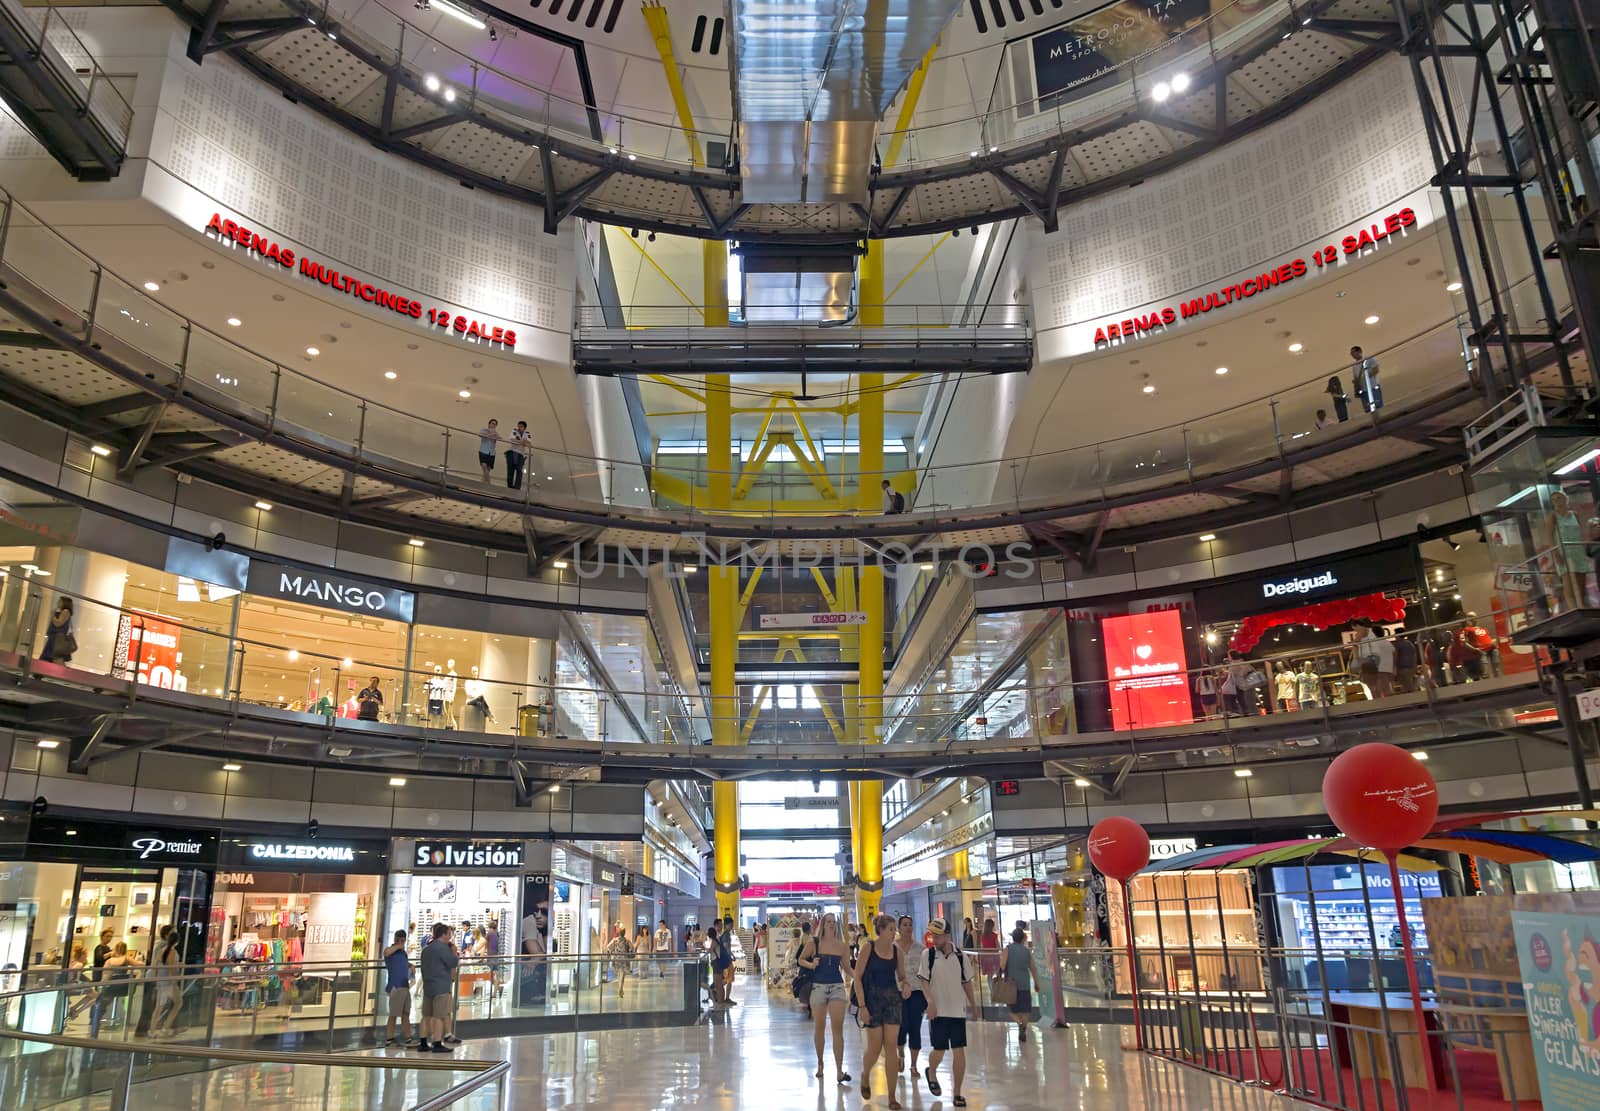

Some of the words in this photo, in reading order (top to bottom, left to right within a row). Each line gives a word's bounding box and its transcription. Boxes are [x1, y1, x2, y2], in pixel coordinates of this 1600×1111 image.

[1050, 0, 1181, 58] METROPOLITA
[205, 212, 295, 268] ARENAS
[300, 257, 422, 319] MULTICINES
[428, 308, 450, 327] 12
[454, 315, 517, 347] SALES
[1094, 307, 1175, 344] ARENAS
[1180, 258, 1307, 319] MULTICINES
[1312, 245, 1338, 267] 12
[1341, 207, 1416, 254] SALES
[280, 573, 385, 610] MANGO
[132, 838, 202, 859] Premier
[252, 844, 354, 861] CALZEDONIA
[416, 845, 519, 865] Solvisión
[1366, 872, 1440, 888] MoilYou
[1544, 1038, 1600, 1077] GELATS
